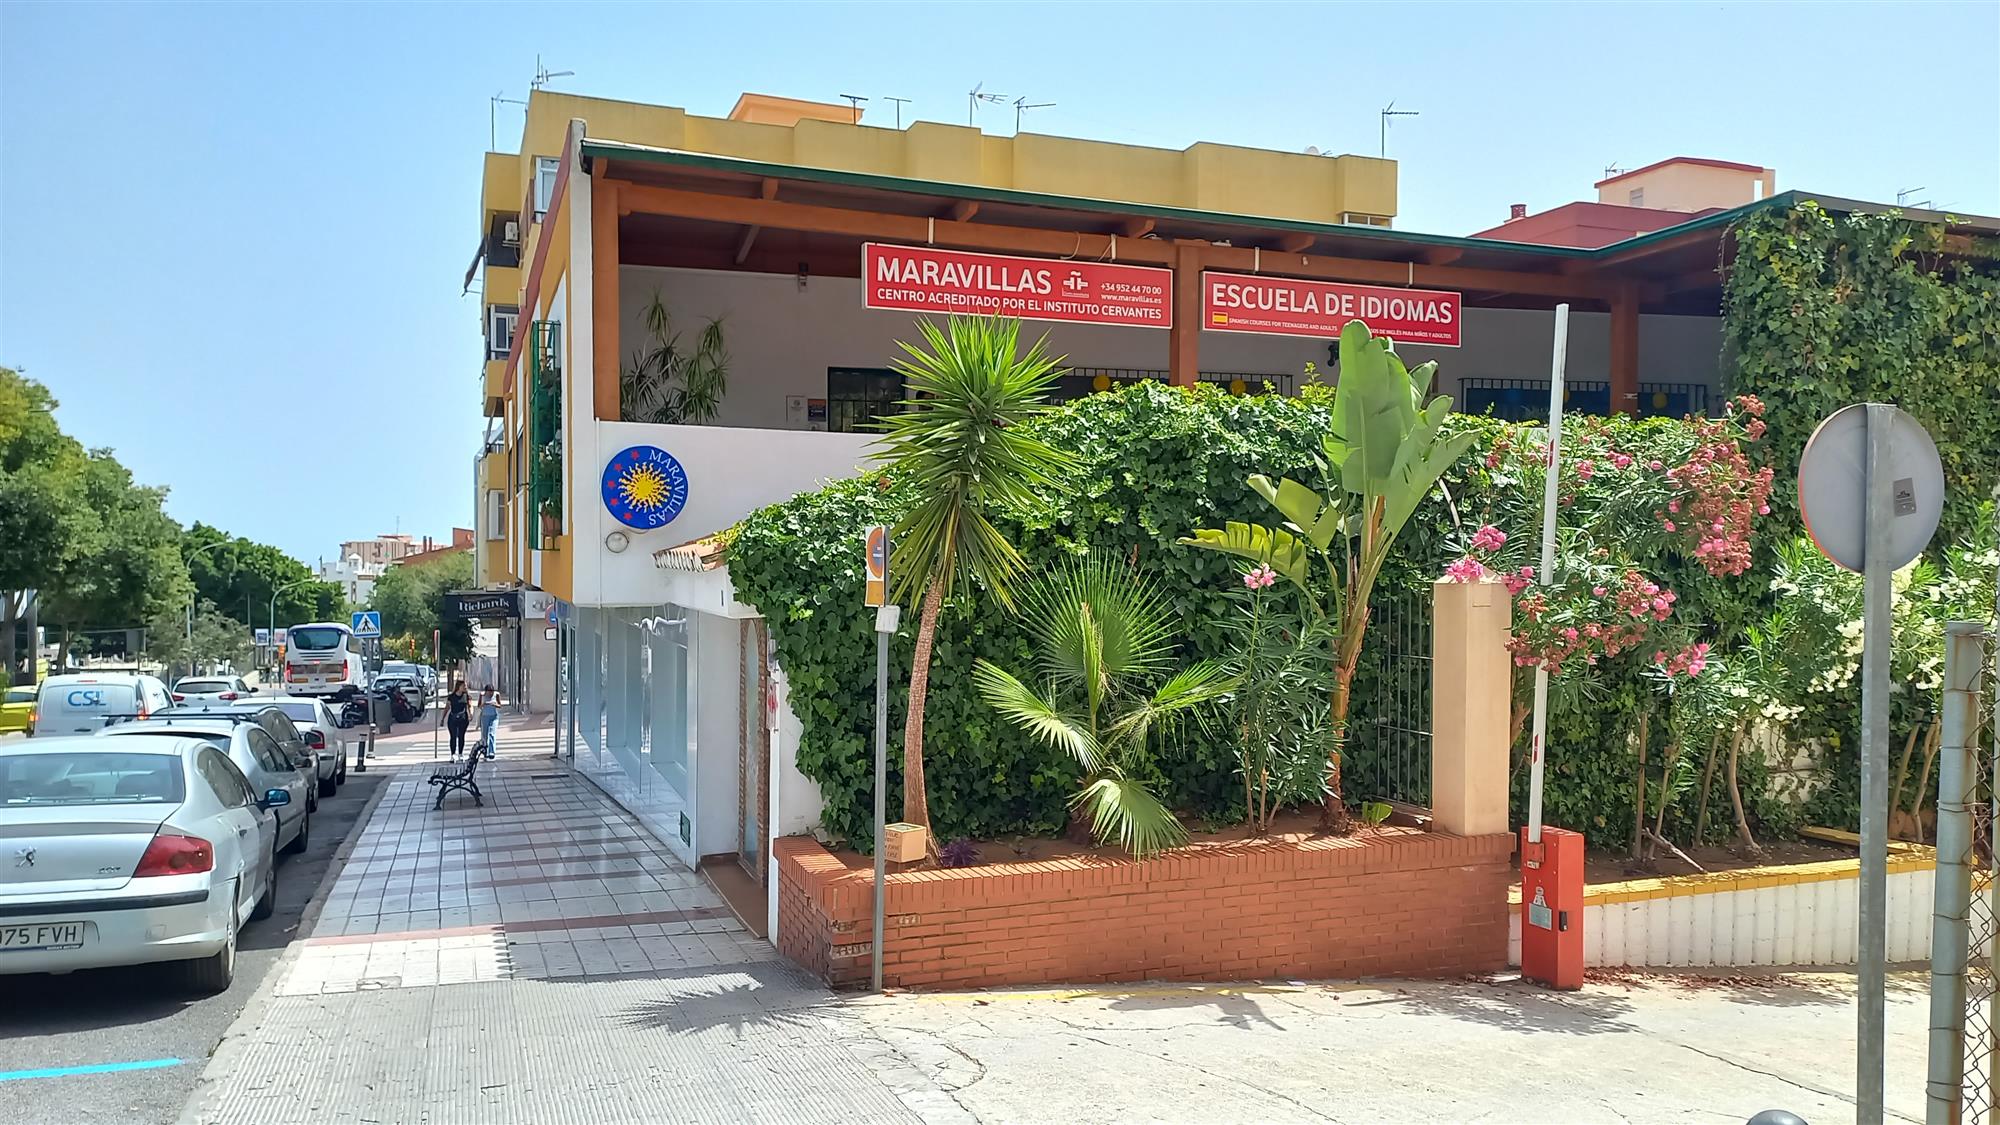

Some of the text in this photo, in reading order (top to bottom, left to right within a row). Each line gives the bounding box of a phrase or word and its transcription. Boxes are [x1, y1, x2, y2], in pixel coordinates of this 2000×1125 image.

[877, 256, 1052, 294] MARAVILLAS
[1100, 282, 1162, 295] +34 952 44 70 00
[877, 288, 1162, 319] CENTRO ACREDITADO POR EL INSTITUTO CERVANTES
[1100, 294, 1162, 304] www.maravillas.es
[1212, 283, 1453, 324] ESCUELA DE IDIOMAS
[1249, 319, 1271, 327] COURSES
[649, 449, 685, 526] MARAVILLAS
[459, 598, 510, 611] Richards
[0, 926, 77, 946] 75 FVH
